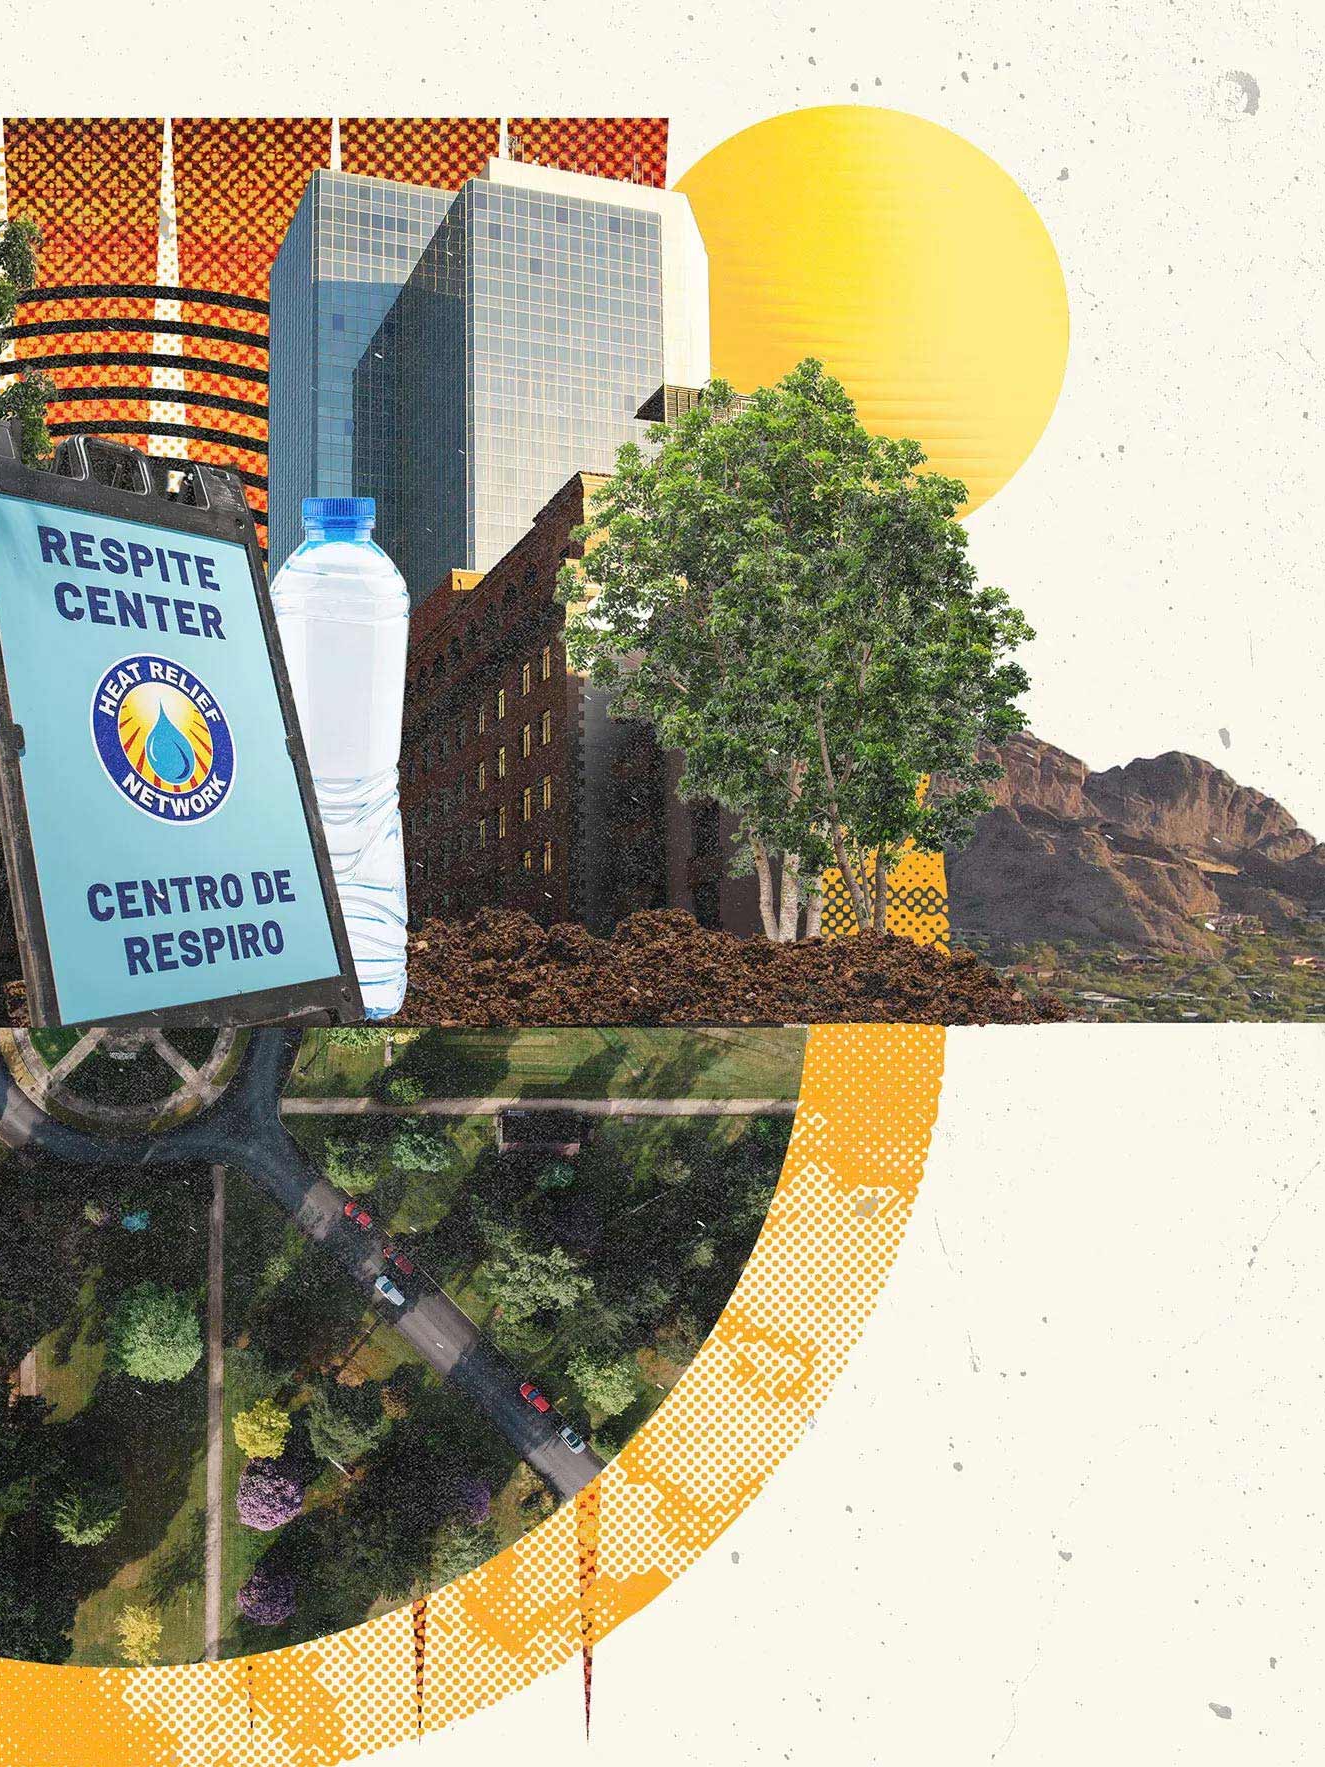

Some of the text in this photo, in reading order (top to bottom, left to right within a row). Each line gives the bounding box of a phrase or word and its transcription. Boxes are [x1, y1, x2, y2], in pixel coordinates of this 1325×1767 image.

[36, 524, 221, 592] RESPITE
[53, 581, 227, 641] CENTER
[99, 660, 221, 722] HEAT RELIEF
[122, 771, 227, 817] NETWORK
[86, 869, 296, 922] CENTRO DE
[123, 920, 285, 977] RESPIRO
